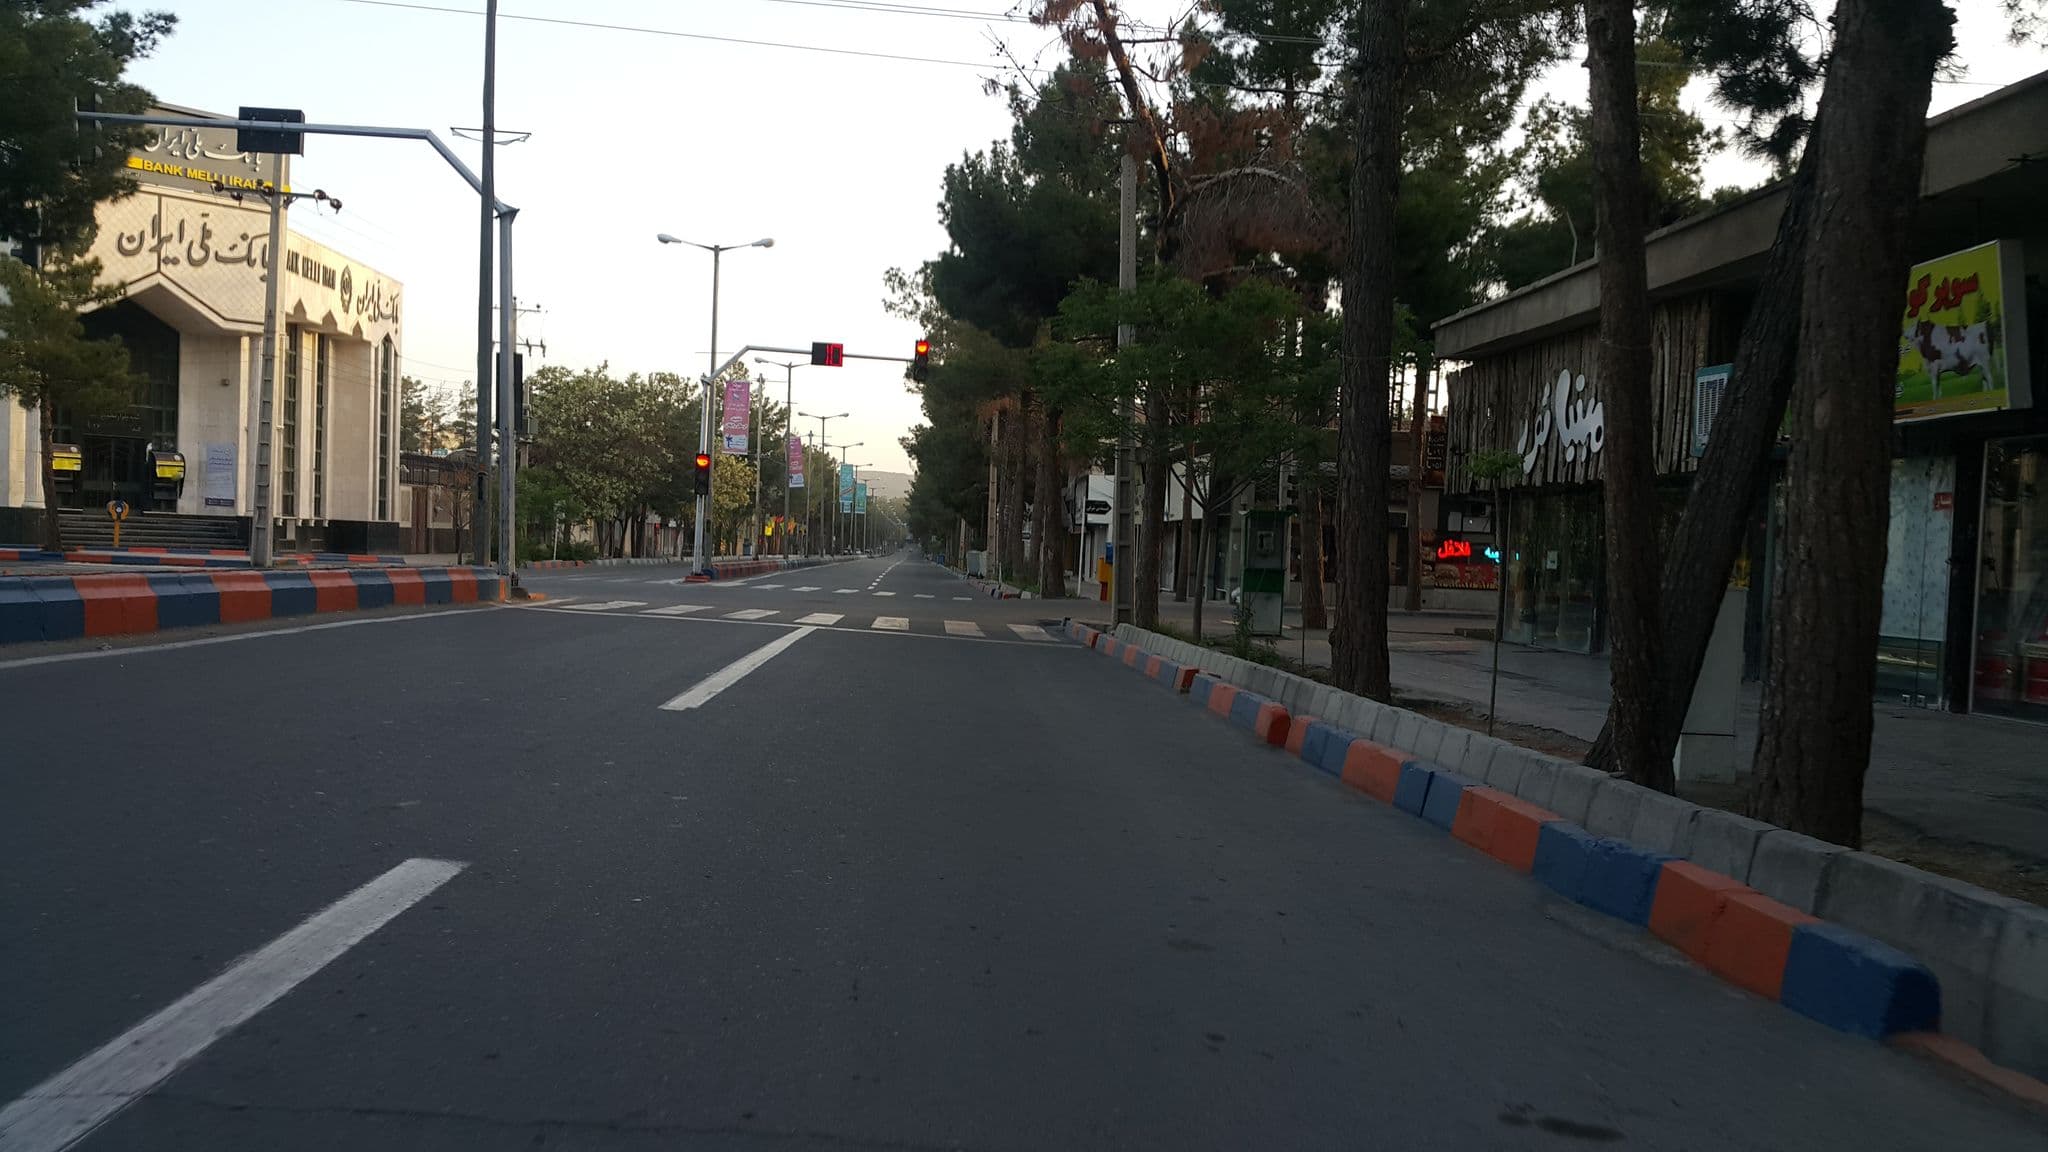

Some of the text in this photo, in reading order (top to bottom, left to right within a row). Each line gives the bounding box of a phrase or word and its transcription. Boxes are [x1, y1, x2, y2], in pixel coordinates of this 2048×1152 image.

[144, 127, 186, 157] ایران
[143, 159, 183, 177] BANK
[186, 167, 227, 184] MELLI
[117, 213, 186, 266] ایران
[214, 231, 270, 282] بانک
[286, 248, 337, 290] ANK MELLI IRAN
[356, 279, 374, 322] ایران
[380, 292, 400, 335] بانک
